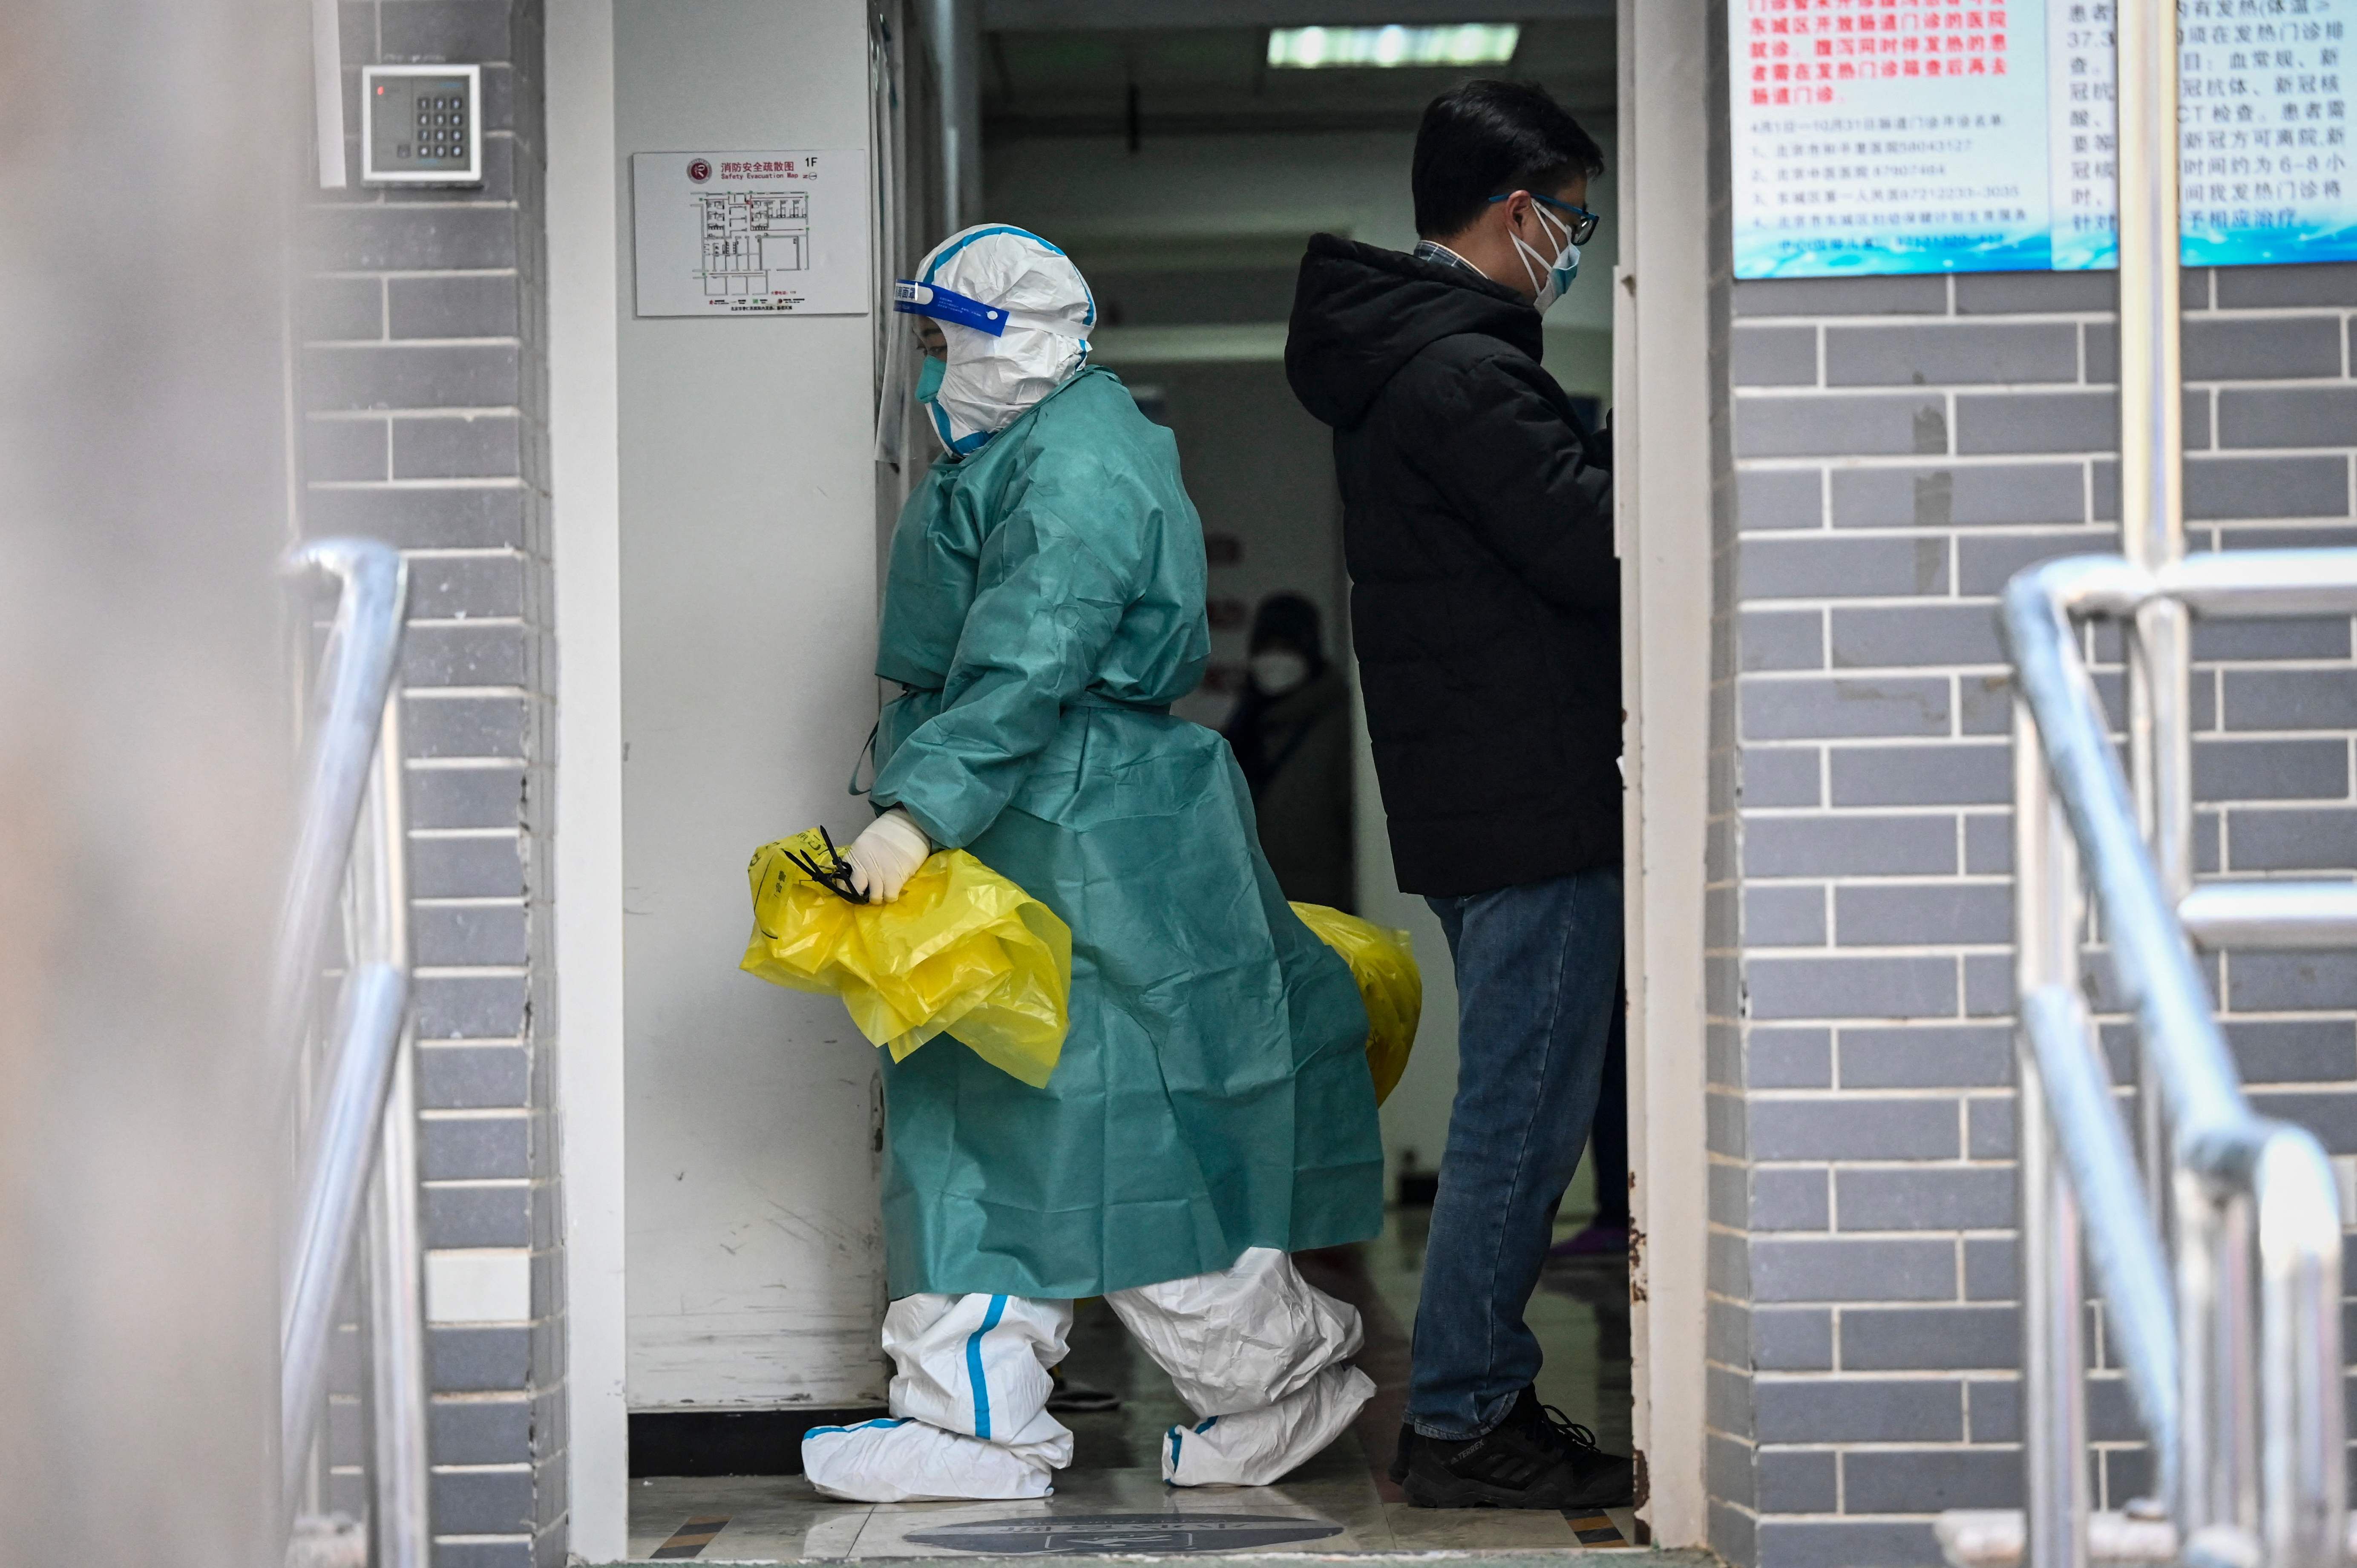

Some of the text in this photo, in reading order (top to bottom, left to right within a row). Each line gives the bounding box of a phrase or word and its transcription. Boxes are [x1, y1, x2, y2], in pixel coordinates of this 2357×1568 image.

[721, 161, 794, 173] 消防安全疏散图
[805, 157, 817, 167] 1F
[1457, 1439, 1485, 1460] TERREX
